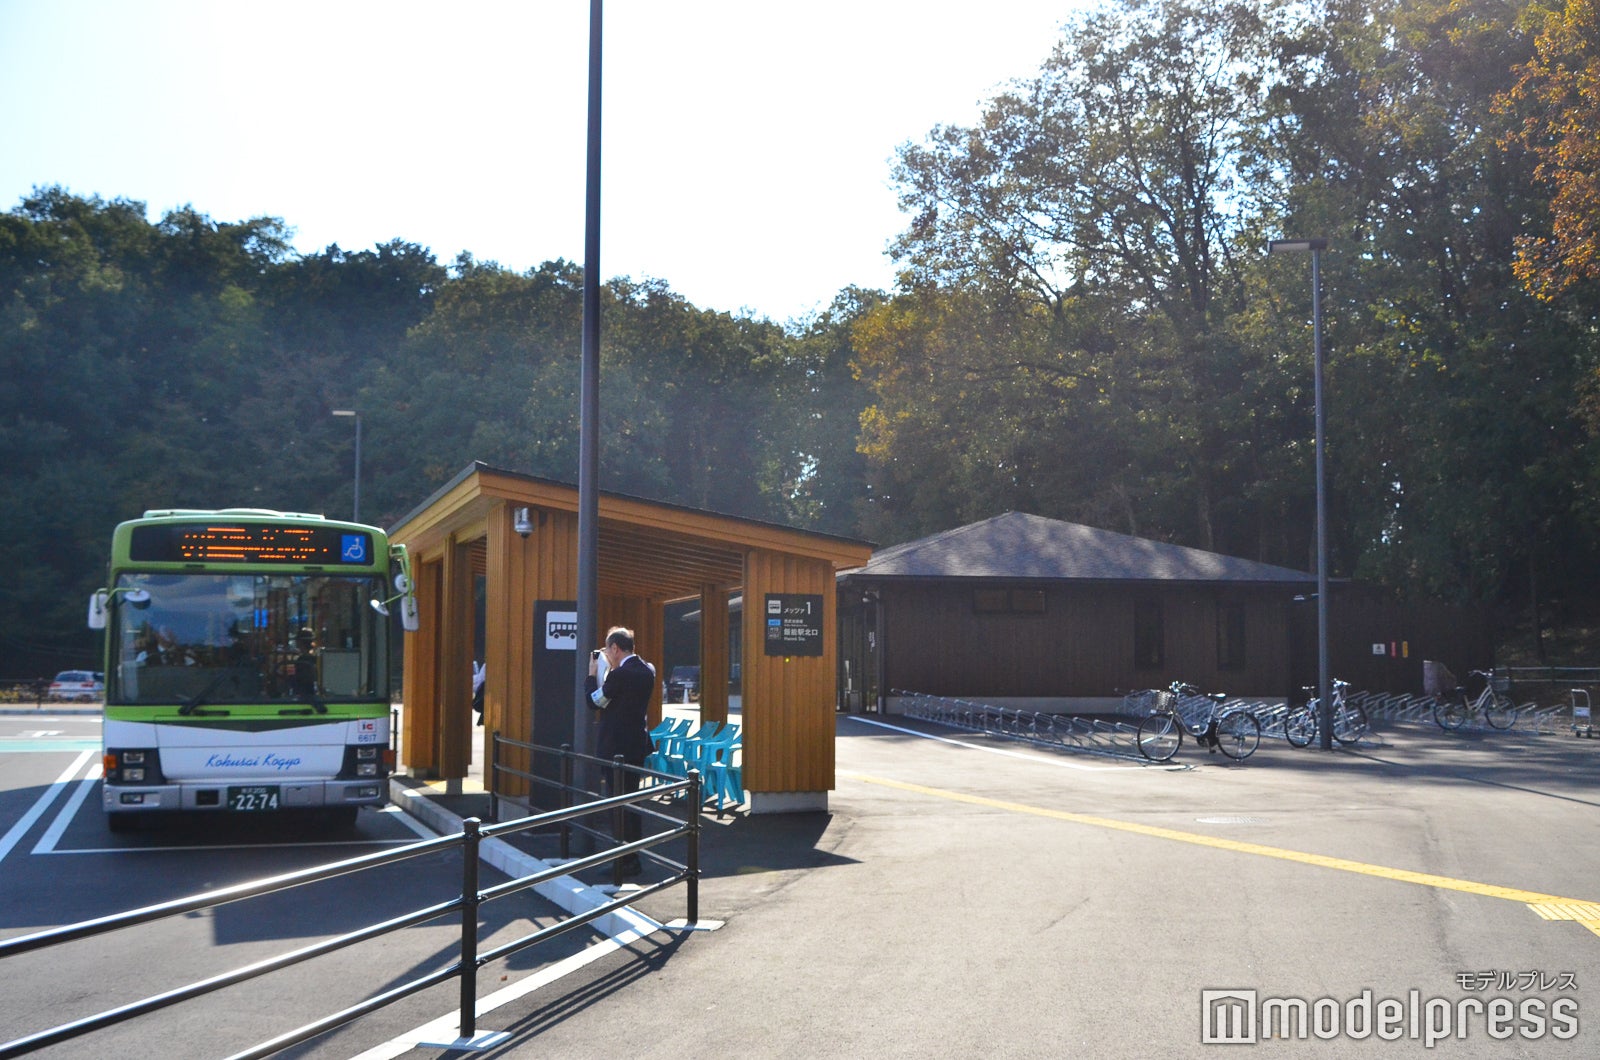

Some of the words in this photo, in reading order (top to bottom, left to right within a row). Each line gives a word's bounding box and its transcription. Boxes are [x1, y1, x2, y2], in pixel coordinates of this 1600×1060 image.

[358, 734, 377, 742] 6617
[205, 754, 260, 767] Kokusai
[262, 753, 301, 769] Kogyo
[235, 793, 278, 810] 22-74
